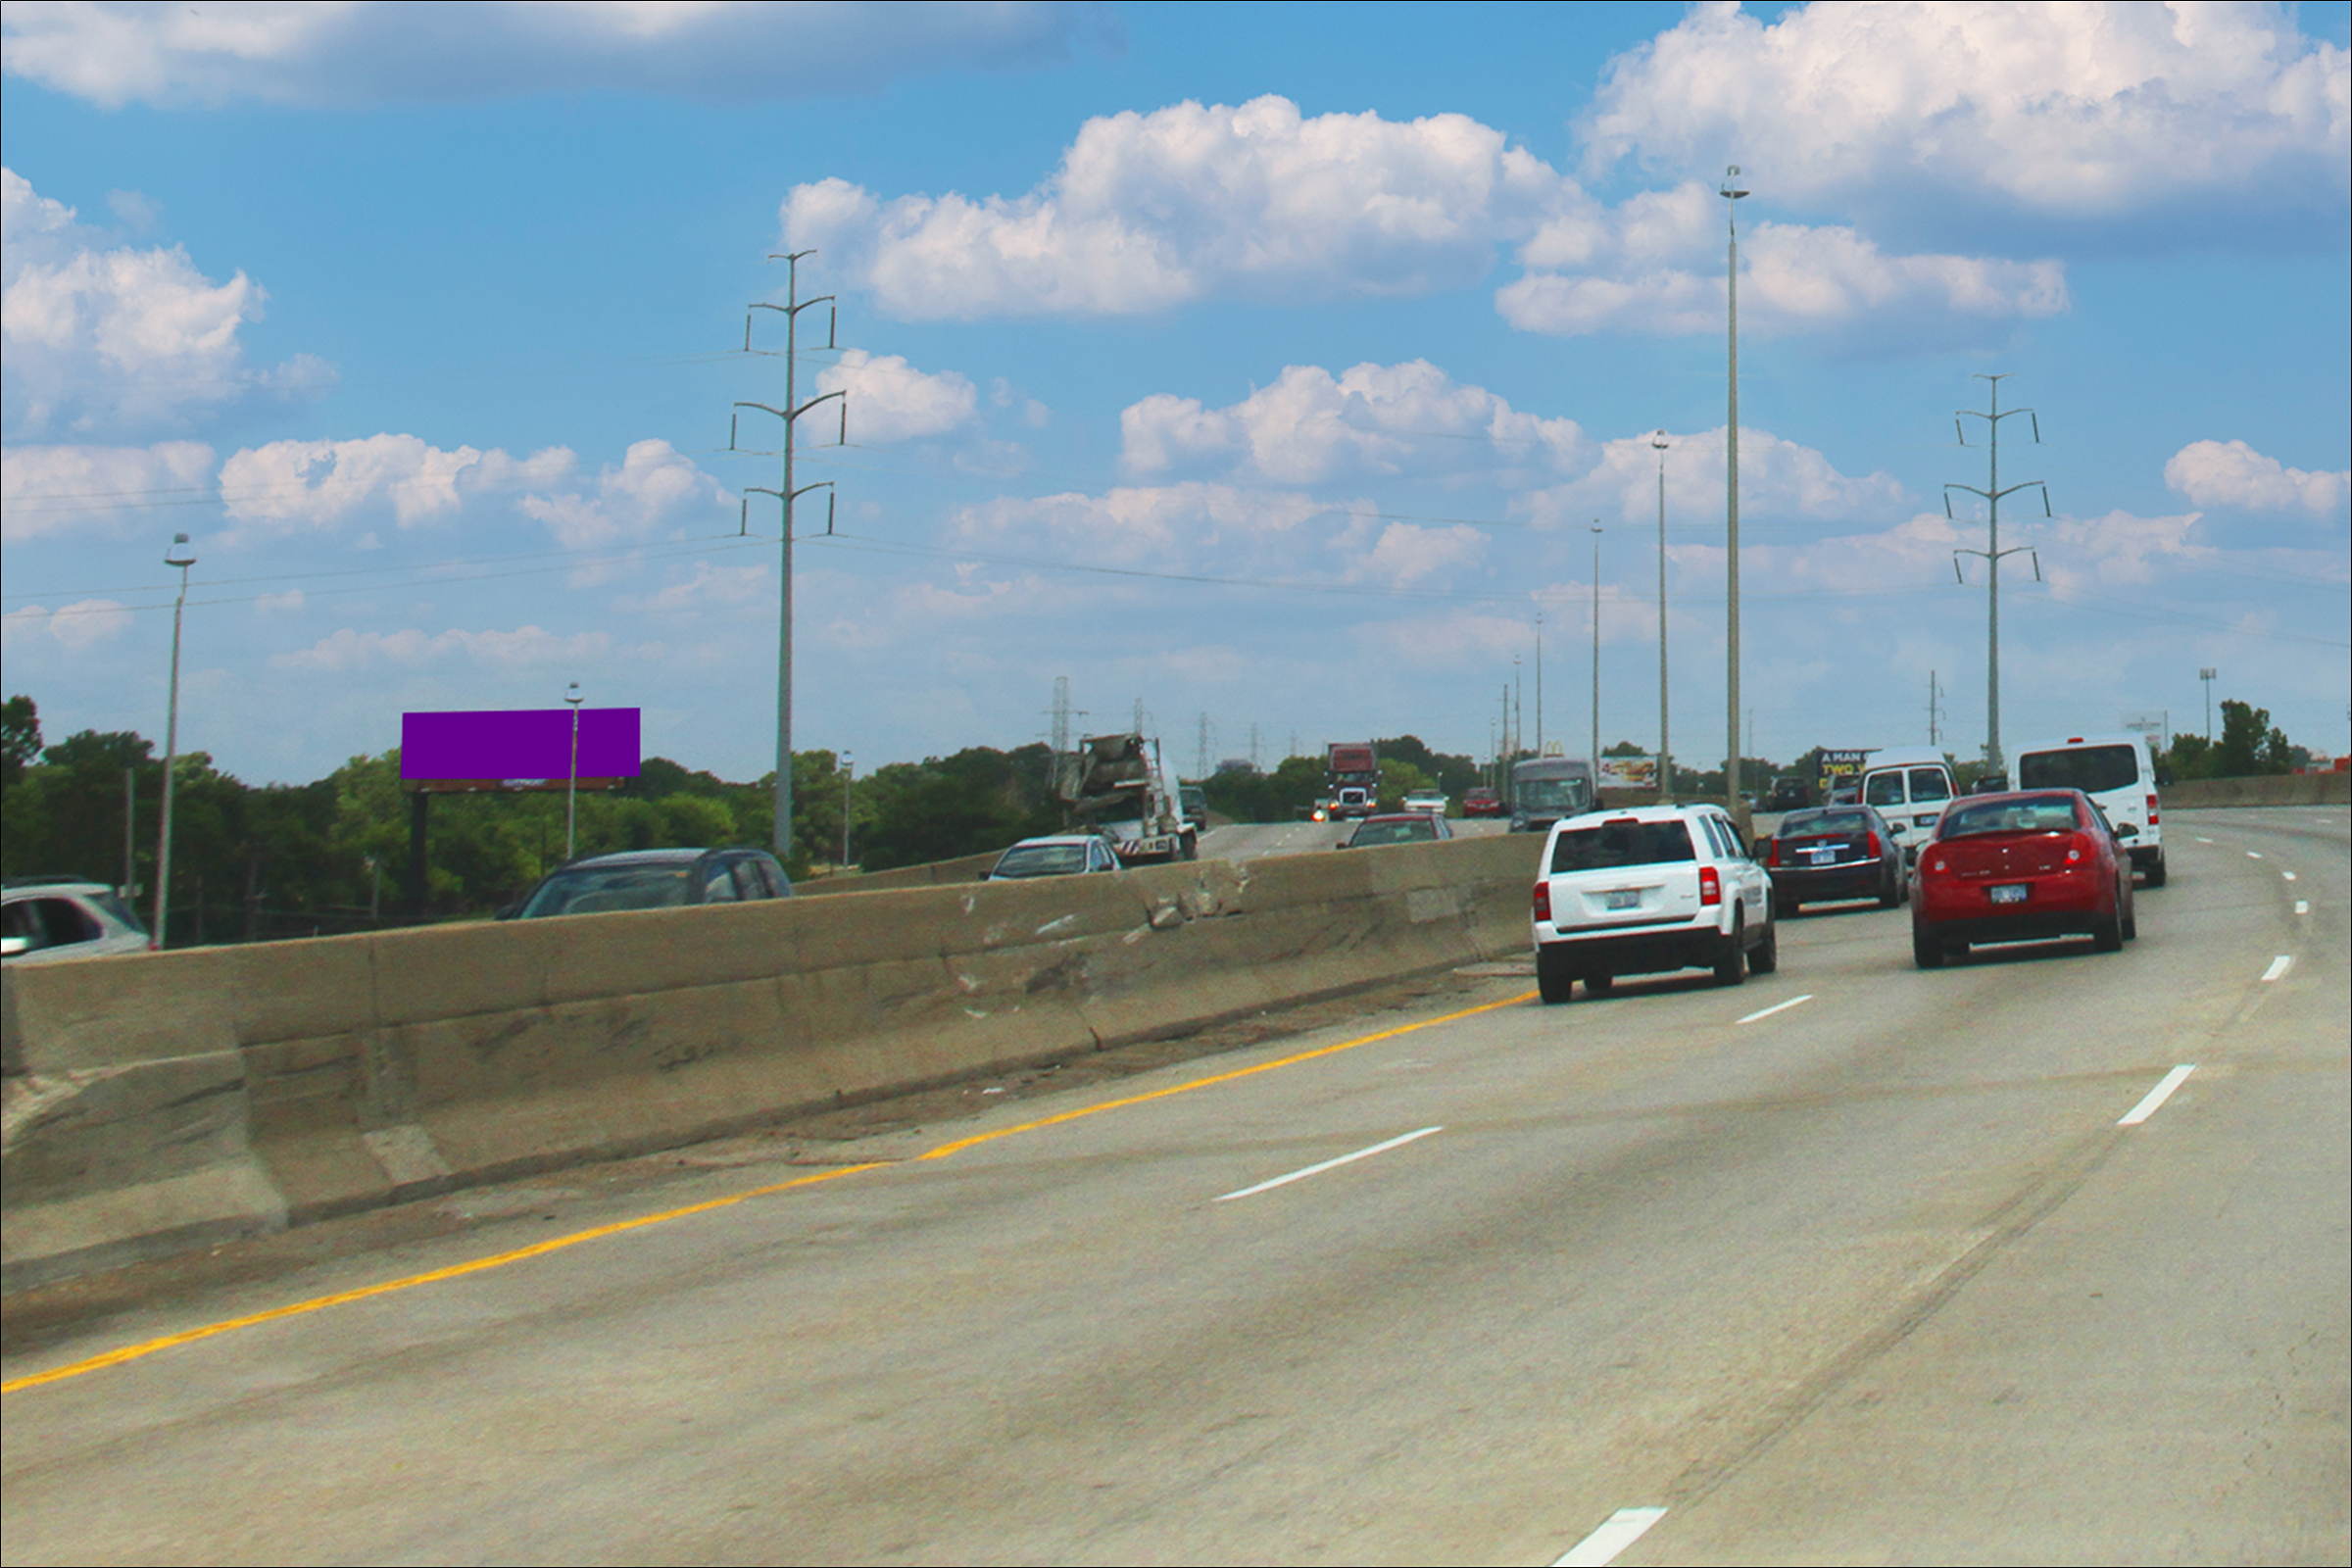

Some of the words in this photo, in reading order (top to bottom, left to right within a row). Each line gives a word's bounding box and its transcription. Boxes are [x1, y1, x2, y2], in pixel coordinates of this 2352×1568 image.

[1822, 752, 1832, 762] A
[1833, 752, 1860, 762] MAN
[1822, 763, 1854, 774] TWO
